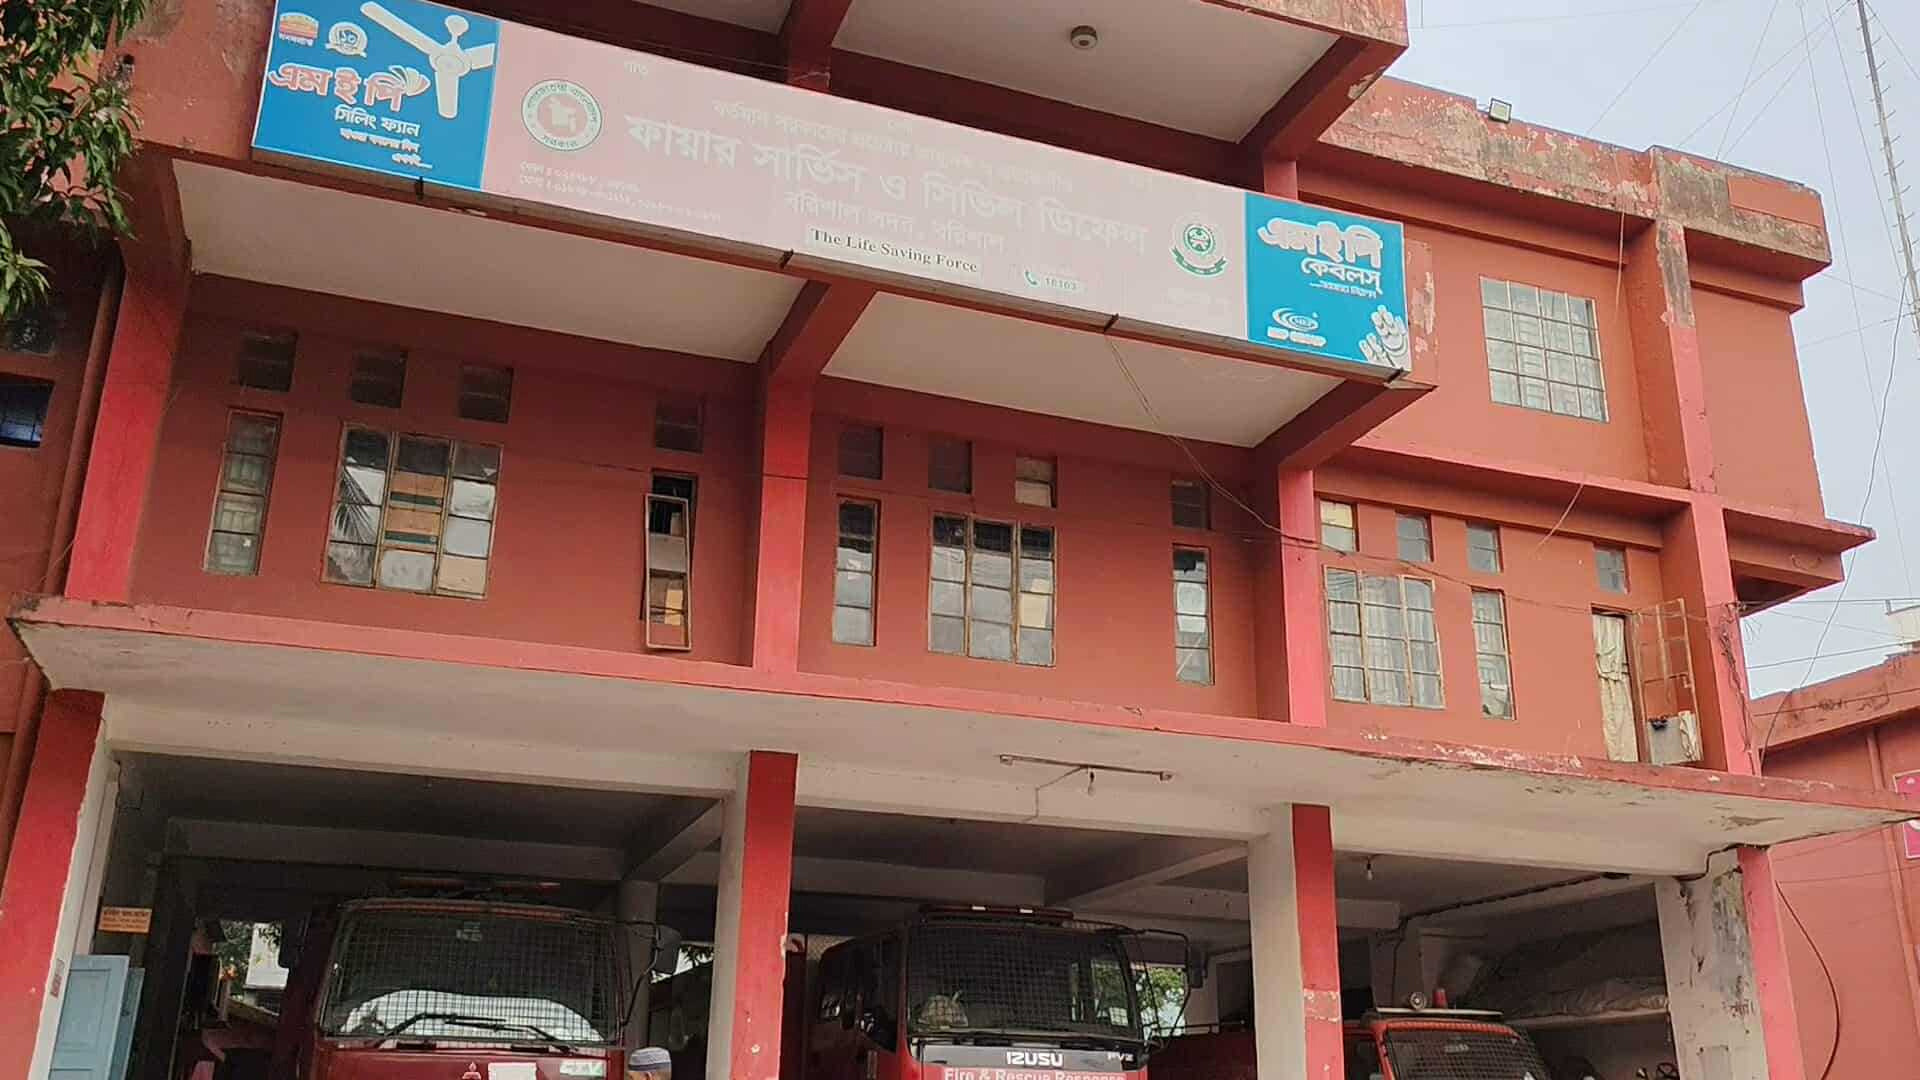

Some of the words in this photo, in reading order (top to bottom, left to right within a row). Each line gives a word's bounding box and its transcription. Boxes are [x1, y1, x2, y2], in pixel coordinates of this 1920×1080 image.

[334, 103, 377, 129] সিলিং
[380, 116, 421, 137] ফ্যান
[751, 144, 870, 192] সার্ভিস
[880, 175, 909, 201] ও
[920, 168, 1031, 232] সিভিল
[810, 228, 842, 245] The
[846, 235, 877, 253] Life
[880, 242, 931, 265] Saving
[936, 254, 978, 273] Force
